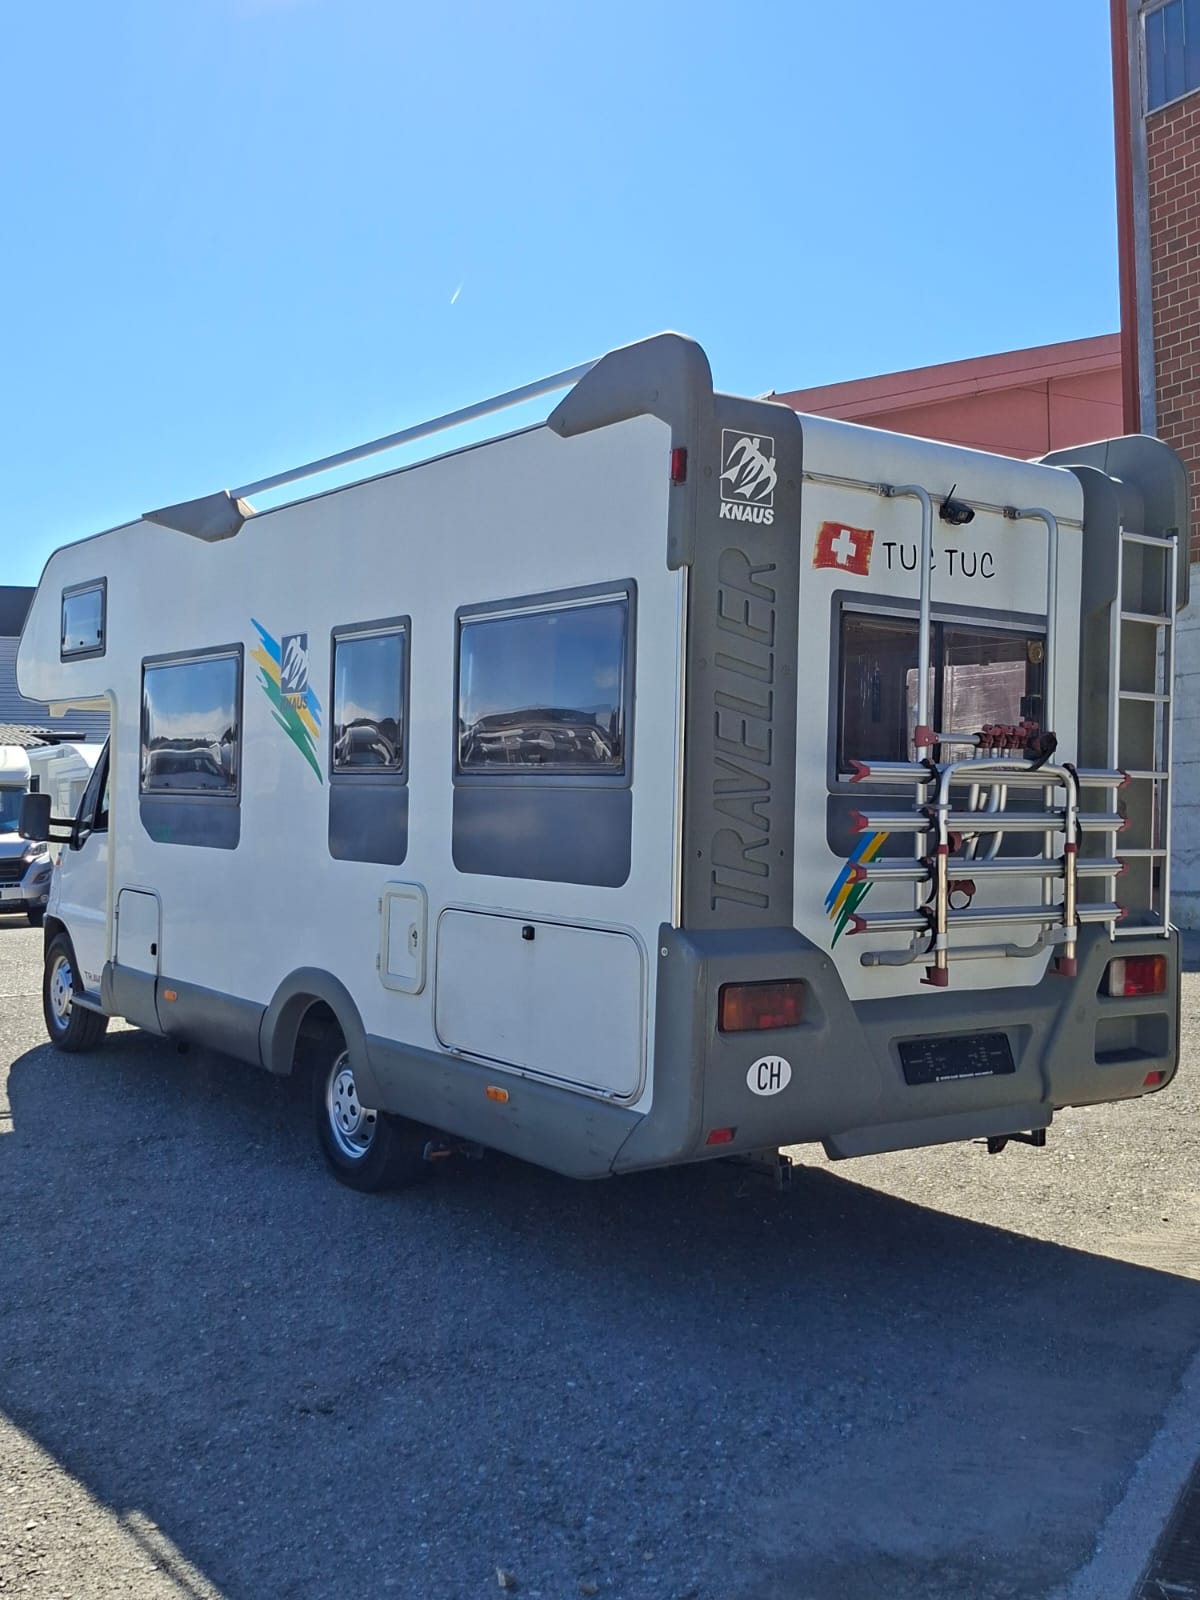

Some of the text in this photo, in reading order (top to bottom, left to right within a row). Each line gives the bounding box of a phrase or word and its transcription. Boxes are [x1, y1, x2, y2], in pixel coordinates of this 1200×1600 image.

[719, 502, 775, 525] KNAUS
[943, 548, 996, 579] TUC
[710, 547, 777, 912] TRAVELLER
[757, 1061, 781, 1090] CH
